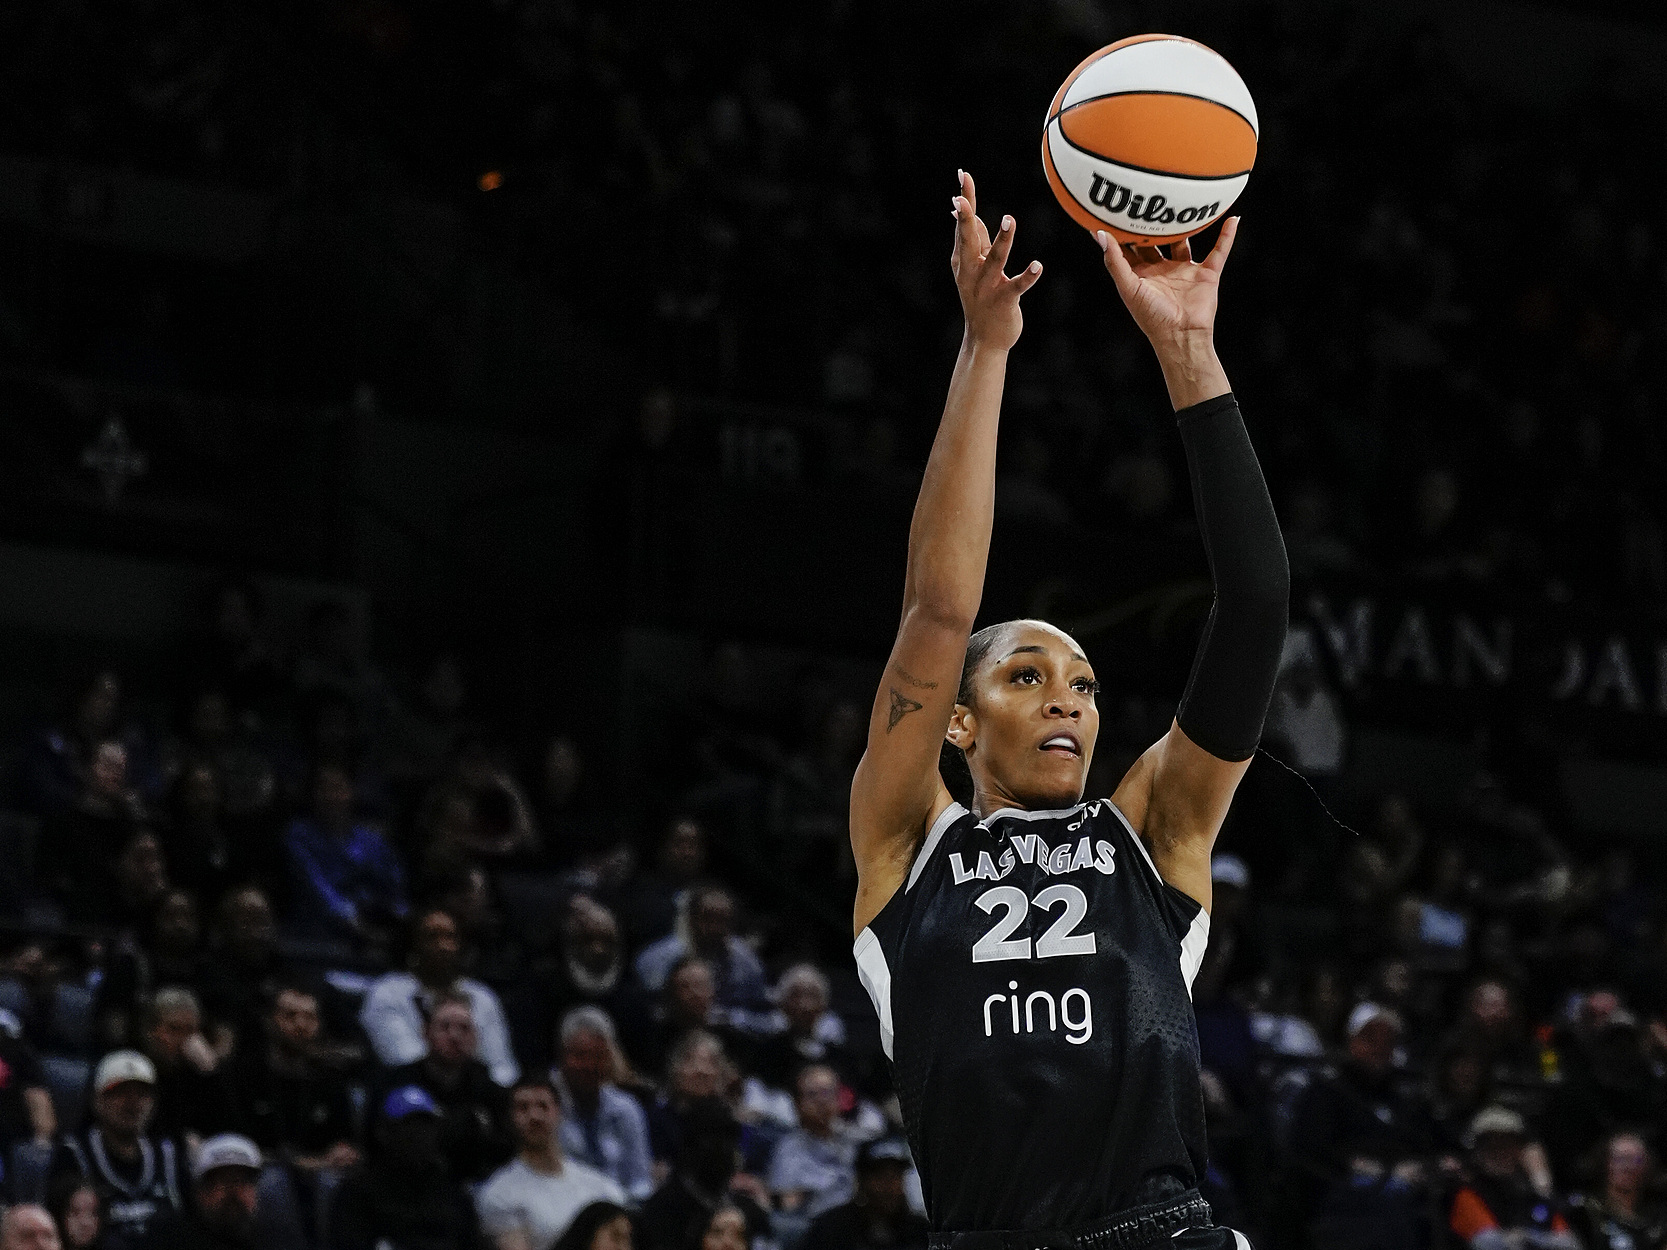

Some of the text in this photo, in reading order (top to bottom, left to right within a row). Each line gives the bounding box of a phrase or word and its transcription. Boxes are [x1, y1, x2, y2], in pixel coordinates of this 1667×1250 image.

[1088, 171, 1220, 224] Wilson
[1548, 635, 1667, 716] JA
[949, 834, 1116, 885] LAS VEGAS
[972, 884, 1097, 963] 22
[983, 980, 1093, 1045] ring
